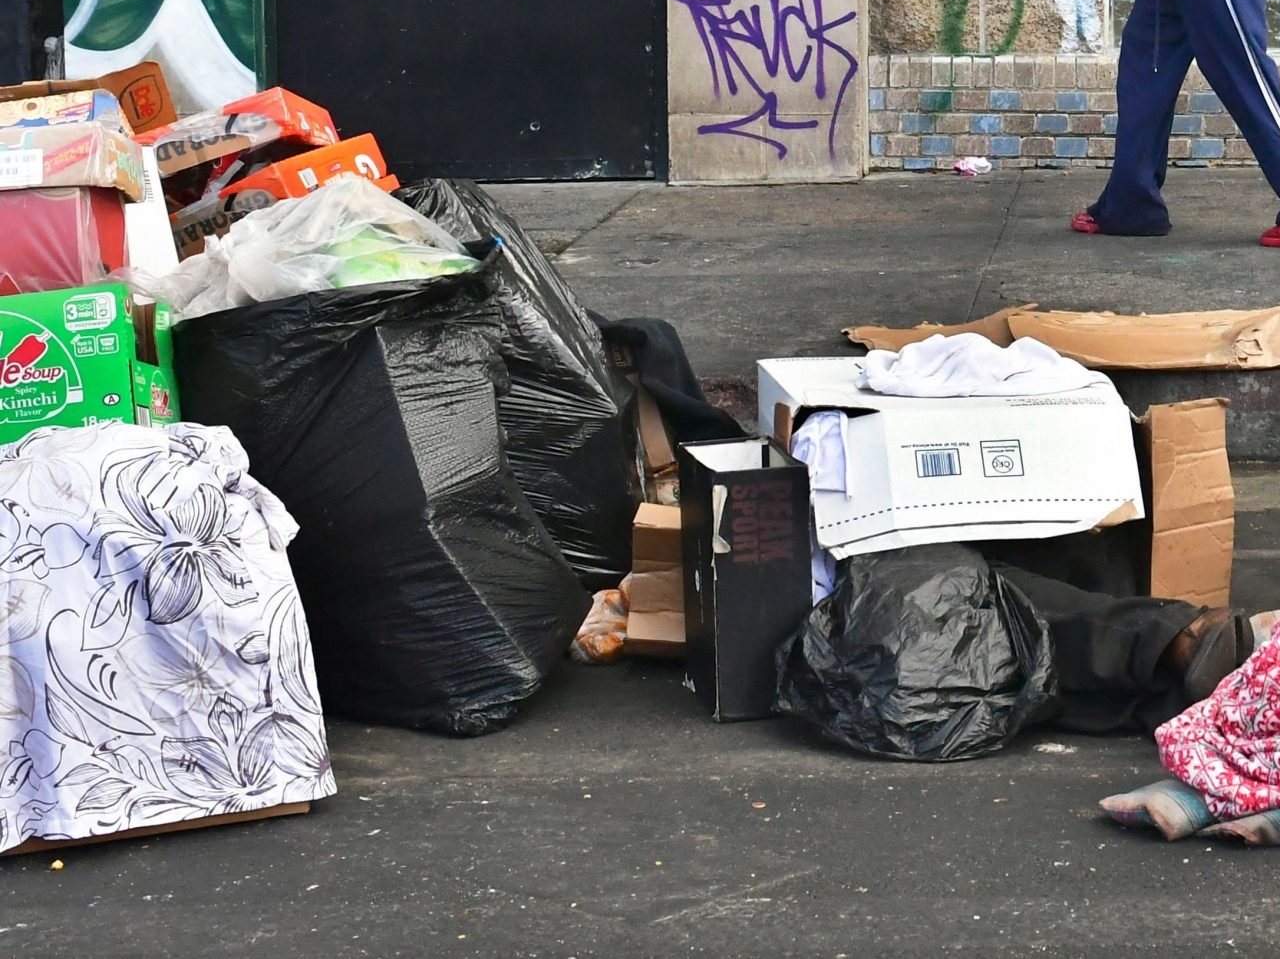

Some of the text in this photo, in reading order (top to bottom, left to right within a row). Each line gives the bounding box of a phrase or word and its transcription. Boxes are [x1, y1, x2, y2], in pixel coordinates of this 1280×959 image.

[66, 303, 93, 320] 3 min
[77, 346, 94, 354] USA
[22, 366, 62, 381] Soup
[15, 386, 37, 396] Spicy
[0, 391, 57, 411] Kimchi
[107, 395, 117, 404] A
[15, 408, 42, 418] Flavor
[81, 415, 97, 427] 18
[731, 484, 759, 563] SPORT
